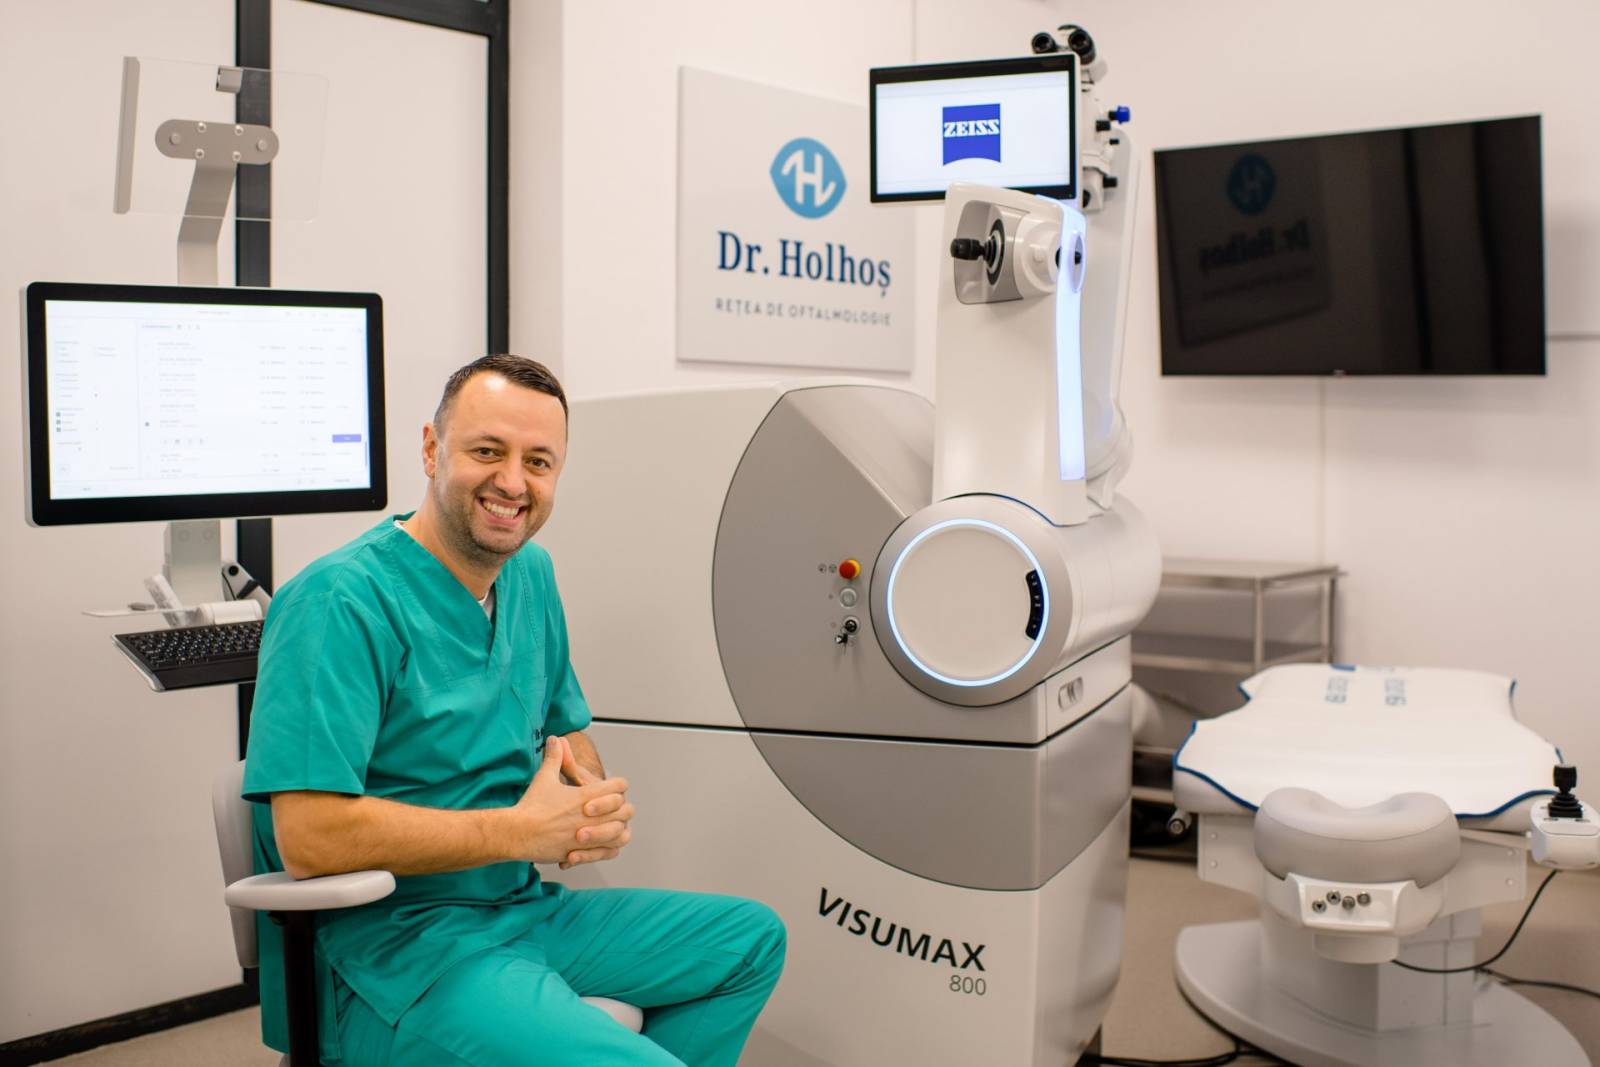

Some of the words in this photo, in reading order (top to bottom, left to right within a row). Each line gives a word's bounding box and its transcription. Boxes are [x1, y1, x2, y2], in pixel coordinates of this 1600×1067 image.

[943, 119, 1001, 138] ZEISS
[718, 231, 770, 275] Dr.
[779, 239, 892, 298] Holhoș
[766, 302, 785, 318] DE
[788, 304, 892, 327] OFTALMOLOGIE
[818, 887, 986, 972] VISUMAX
[948, 974, 987, 997] 800
